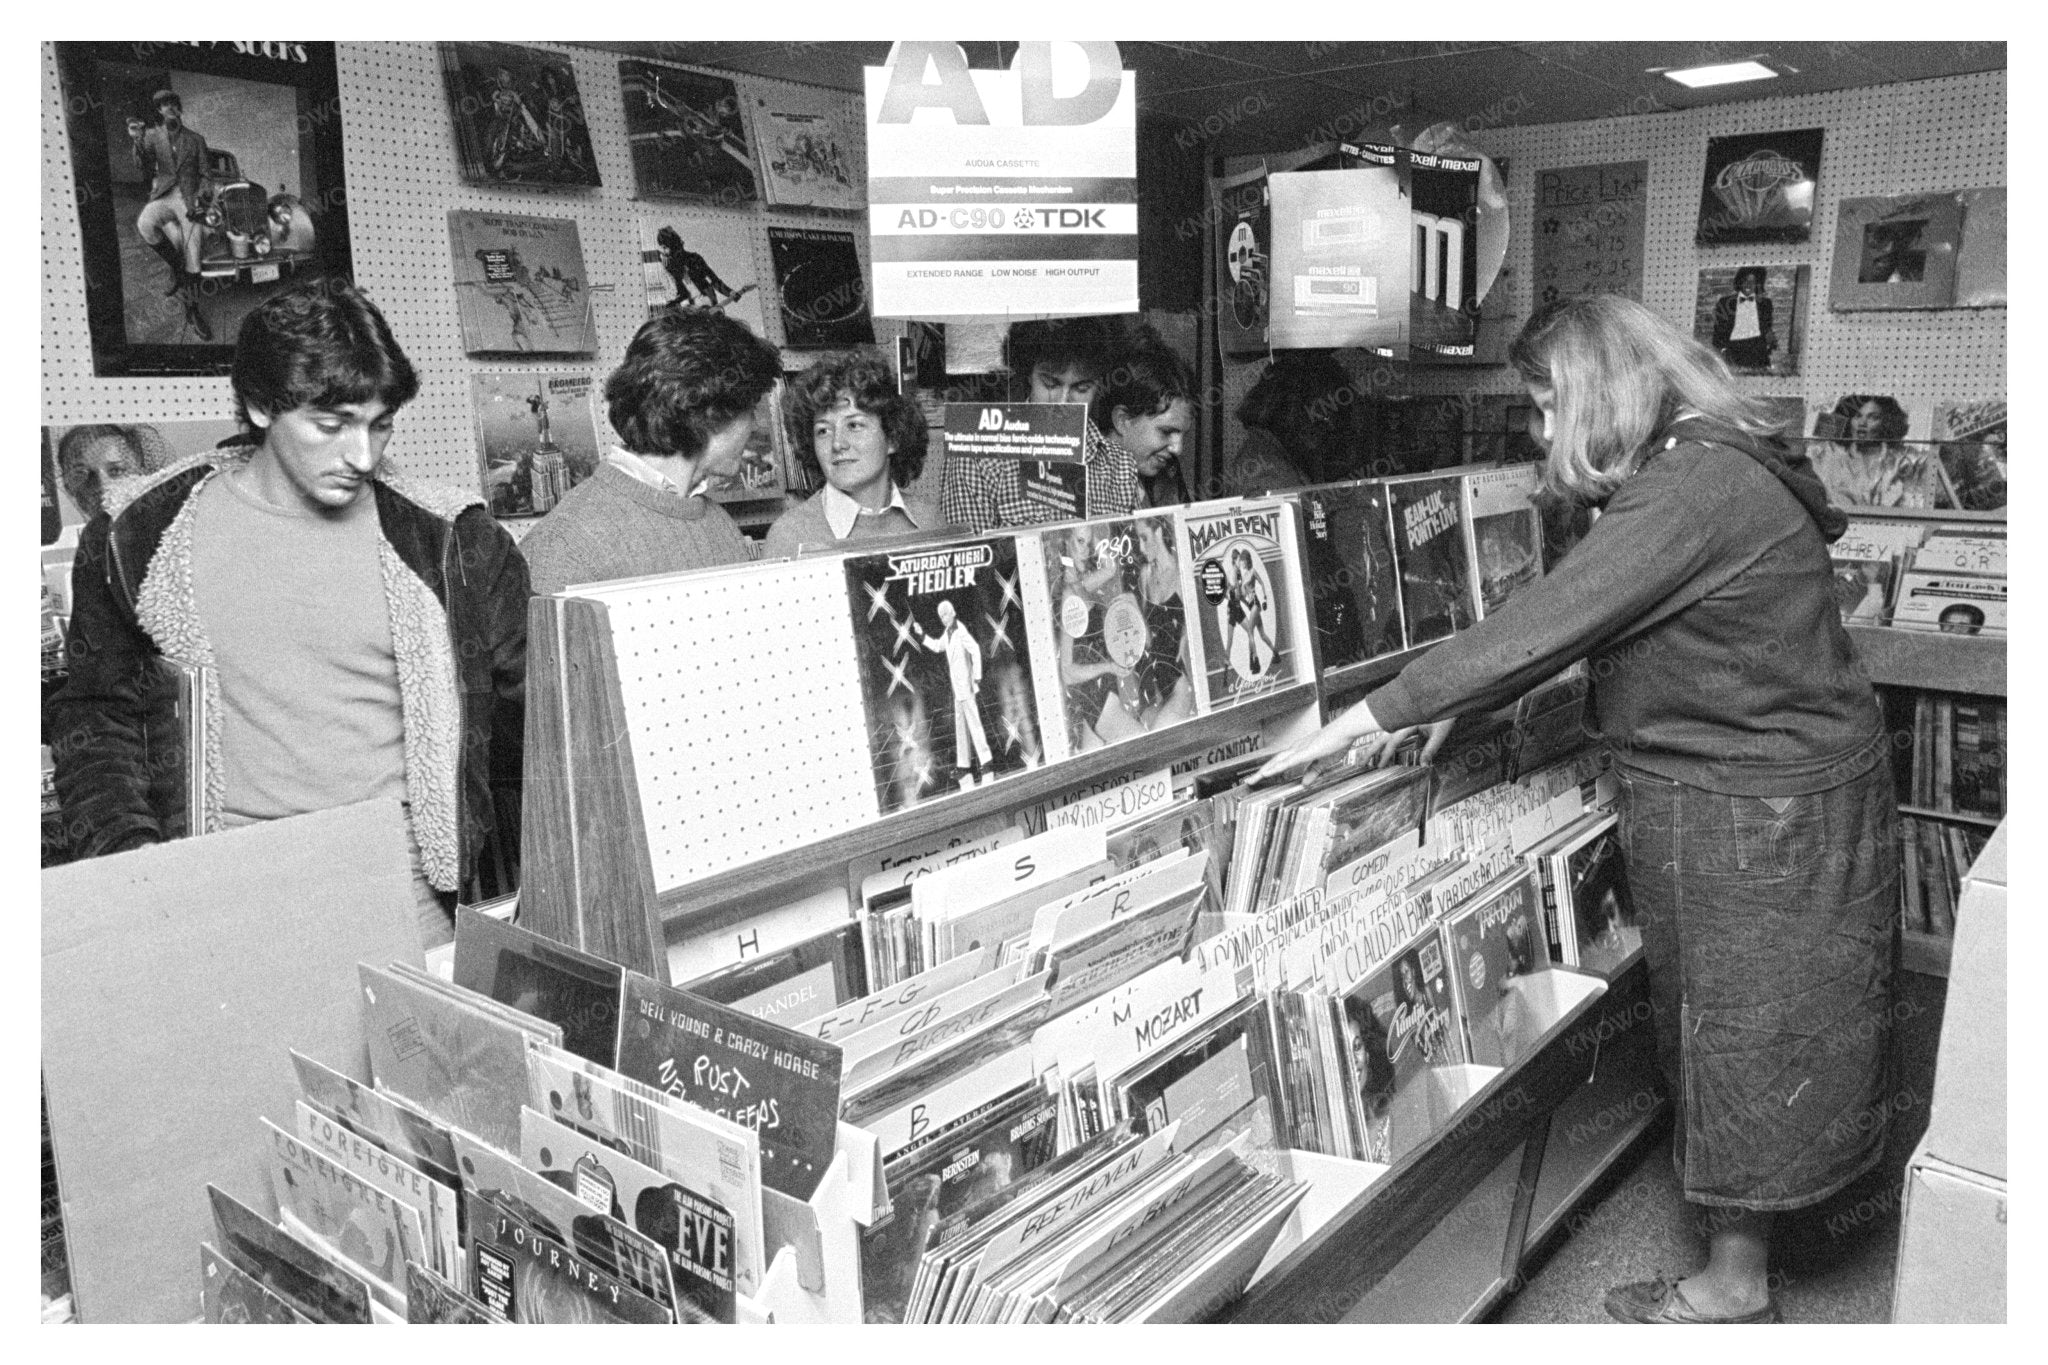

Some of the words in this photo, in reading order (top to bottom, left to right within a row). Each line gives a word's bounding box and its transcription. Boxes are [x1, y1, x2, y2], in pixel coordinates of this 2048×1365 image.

[965, 159, 995, 168] AUDUA
[997, 159, 1040, 168] CASSETTE
[1362, 150, 1395, 164] CASSETTES
[1410, 152, 1437, 167] axell
[1441, 158, 1480, 172] maxell
[930, 185, 954, 196] Super
[956, 185, 991, 195] Precision
[993, 185, 1027, 195] Cassette
[1029, 184, 1073, 194] Mechanism
[1543, 174, 1593, 204] Price
[1599, 170, 1643, 200] List
[898, 208, 1005, 229] AD-C90
[1035, 208, 1106, 228] TDK
[907, 269, 952, 278] EXTENDED
[954, 269, 984, 278] RANGE
[992, 269, 1010, 277] LOW
[1012, 269, 1037, 277] NOISE
[1045, 268, 1066, 277] HIGH
[1067, 268, 1100, 277] OUTPUT
[1309, 266, 1346, 275] maxell
[978, 409, 1003, 430] AD
[944, 432, 953, 441] The
[975, 433, 980, 442] in
[971, 444, 982, 453] tape
[1021, 445, 1032, 454] and
[1228, 506, 1242, 517] THE
[1404, 490, 1444, 530] JEAN-LUC
[1095, 535, 1131, 559] RSO
[1187, 520, 1232, 561] MAIN
[1235, 513, 1280, 543] EVENT
[1829, 541, 1888, 560] MPHREY
[885, 554, 951, 581] SATURDAY
[954, 547, 984, 566] NIGHT
[908, 566, 977, 596] FIEDLER
[1543, 803, 1555, 830] A
[1013, 855, 1036, 882] S
[1352, 852, 1391, 885] COMEDY
[1111, 890, 1132, 920] R
[737, 929, 761, 958] H
[1345, 911, 1407, 984] CLAUDJA
[751, 985, 817, 1019] HANDEL
[1113, 1003, 1131, 1026] M
[1135, 988, 1204, 1052] MOZART
[640, 999, 665, 1022] NEIL
[670, 1010, 710, 1039] YOUNG
[727, 1033, 769, 1061] CRAZY
[774, 1049, 821, 1081] HORSE
[693, 1055, 751, 1099] RUST
[910, 1103, 930, 1141] B
[1010, 1114, 1037, 1142] BRAHMS
[1036, 1104, 1057, 1127] SONGS
[942, 1149, 980, 1182] BERNSTEIN
[1020, 1148, 1145, 1244] BEETHOVEN
[676, 1204, 729, 1277] EVE
[501, 1219, 620, 1304] JOURNEY
[609, 1236, 667, 1305] EVE
